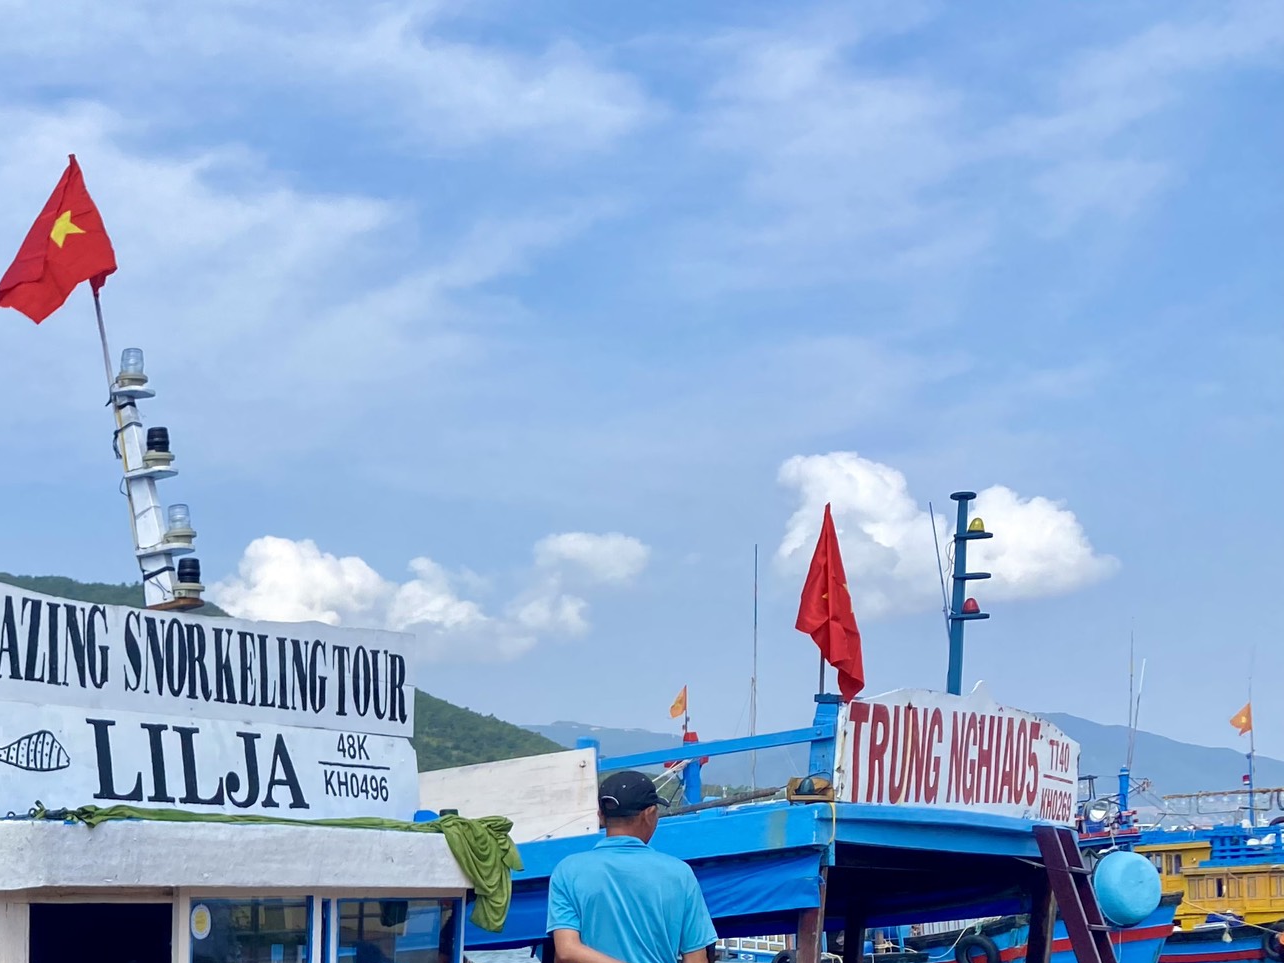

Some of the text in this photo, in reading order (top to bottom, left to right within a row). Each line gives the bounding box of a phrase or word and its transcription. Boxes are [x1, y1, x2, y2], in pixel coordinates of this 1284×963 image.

[124, 610, 328, 714] SNORKELING
[333, 645, 407, 724] TOUR
[86, 718, 310, 809] LILJA
[337, 734, 369, 761] 48K
[1049, 739, 1070, 773] TT40
[324, 769, 389, 801] KH0496
[1040, 788, 1072, 822] KH0269
